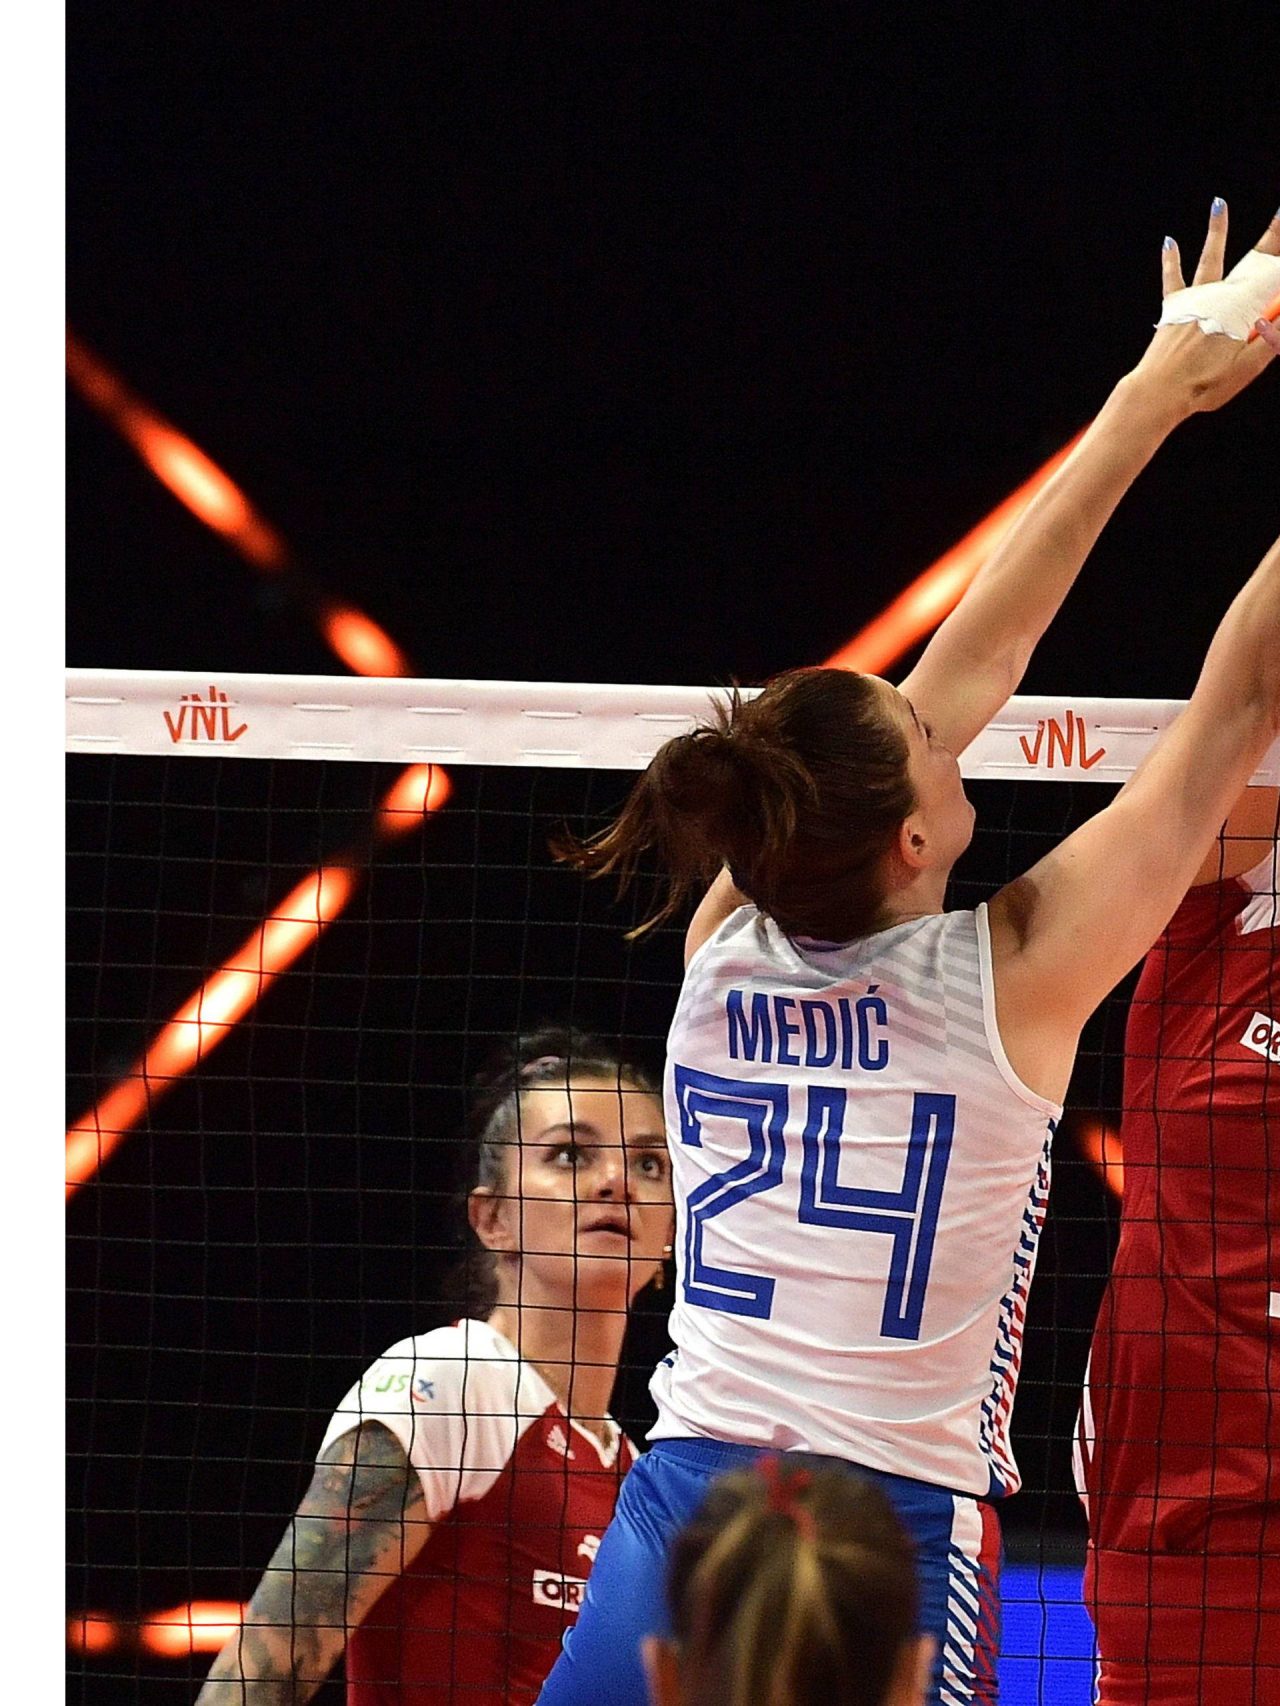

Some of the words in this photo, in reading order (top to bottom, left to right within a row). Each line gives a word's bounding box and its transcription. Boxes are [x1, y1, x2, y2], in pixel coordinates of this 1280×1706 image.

[163, 686, 248, 743] VNL
[1019, 710, 1106, 769] VNL
[726, 984, 889, 1071] MEDIĆ
[674, 1064, 957, 1341] 24
[541, 1578, 580, 1606] OR
